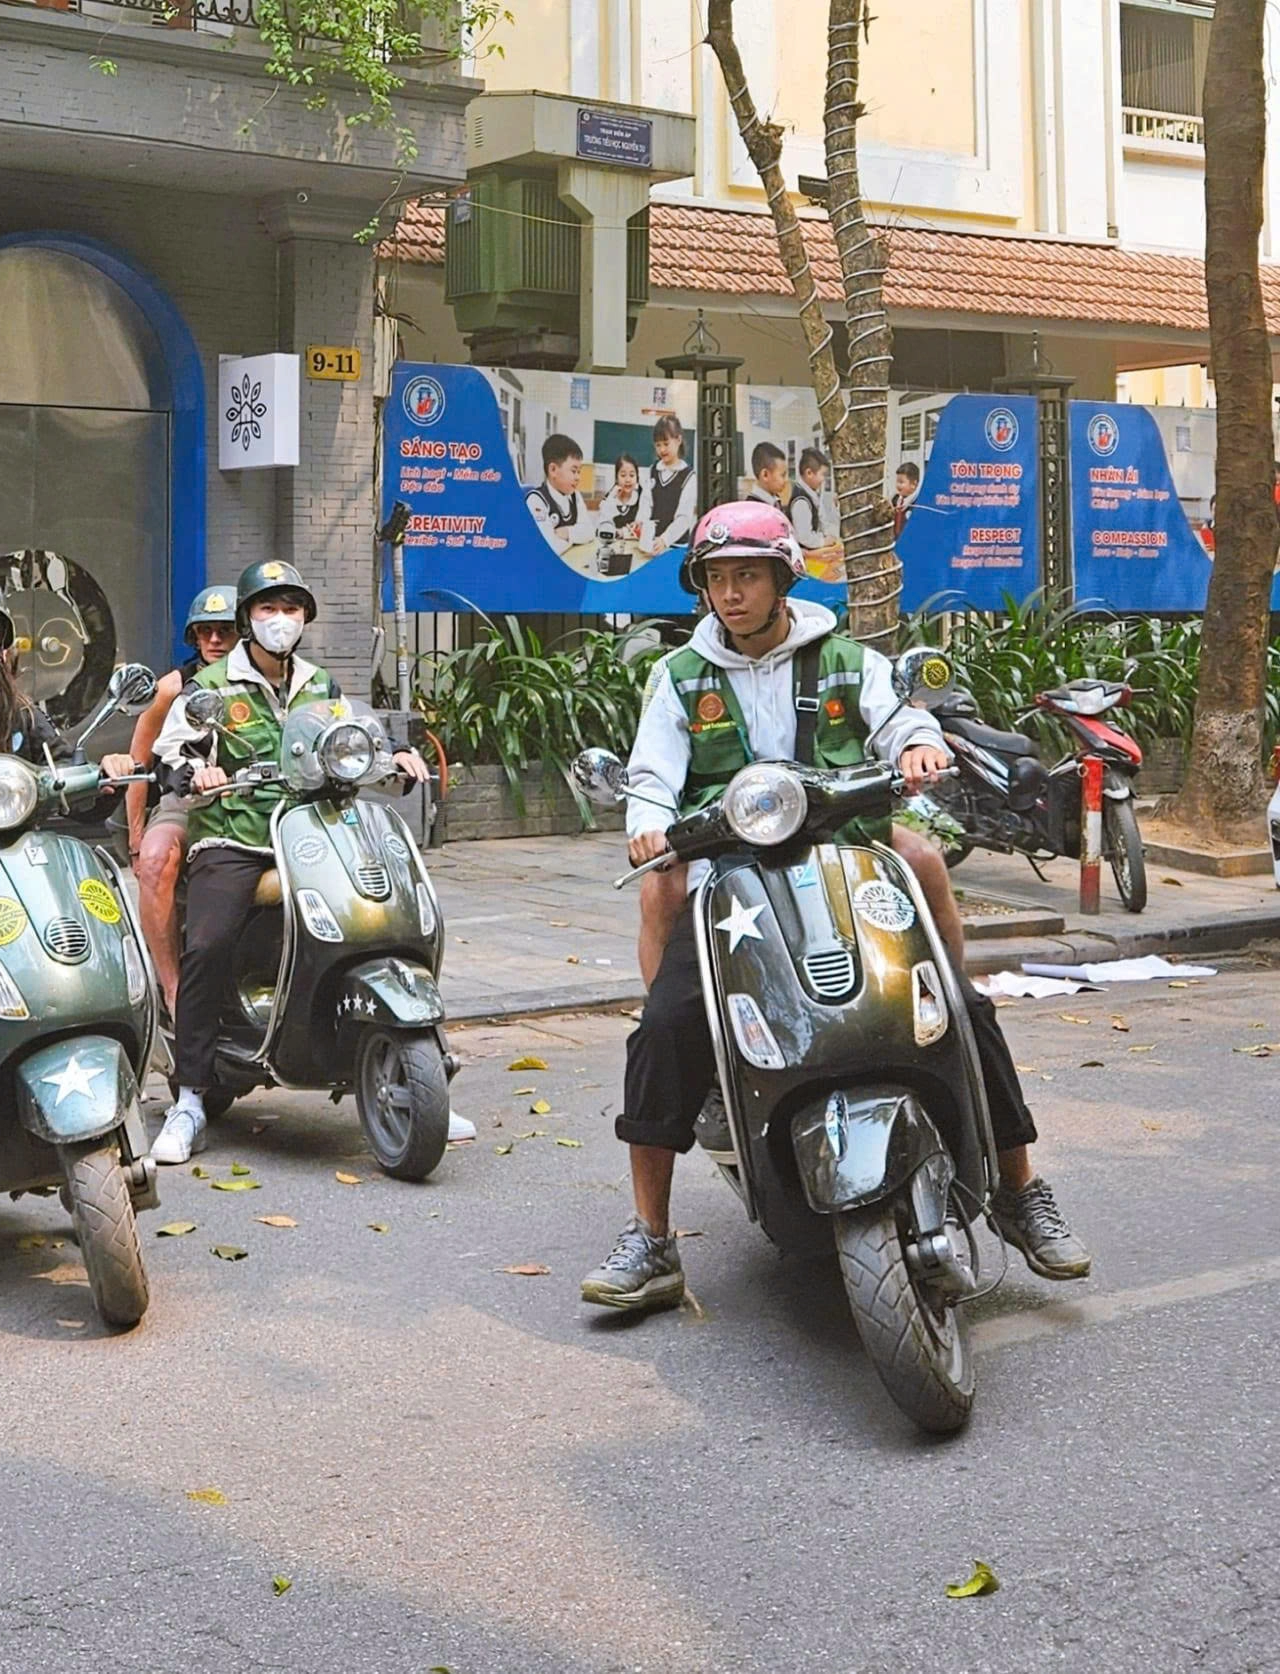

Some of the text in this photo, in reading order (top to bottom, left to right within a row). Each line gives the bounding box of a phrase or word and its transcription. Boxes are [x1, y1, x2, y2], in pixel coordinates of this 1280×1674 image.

[313, 352, 355, 374] 9-11
[401, 436, 481, 464] SÁNG TẠO
[950, 459, 1023, 482] TÔN TRỌNG
[1090, 465, 1124, 483] NHÂN
[970, 528, 1021, 543] RESPECT
[1092, 530, 1167, 546] COMPASSION
